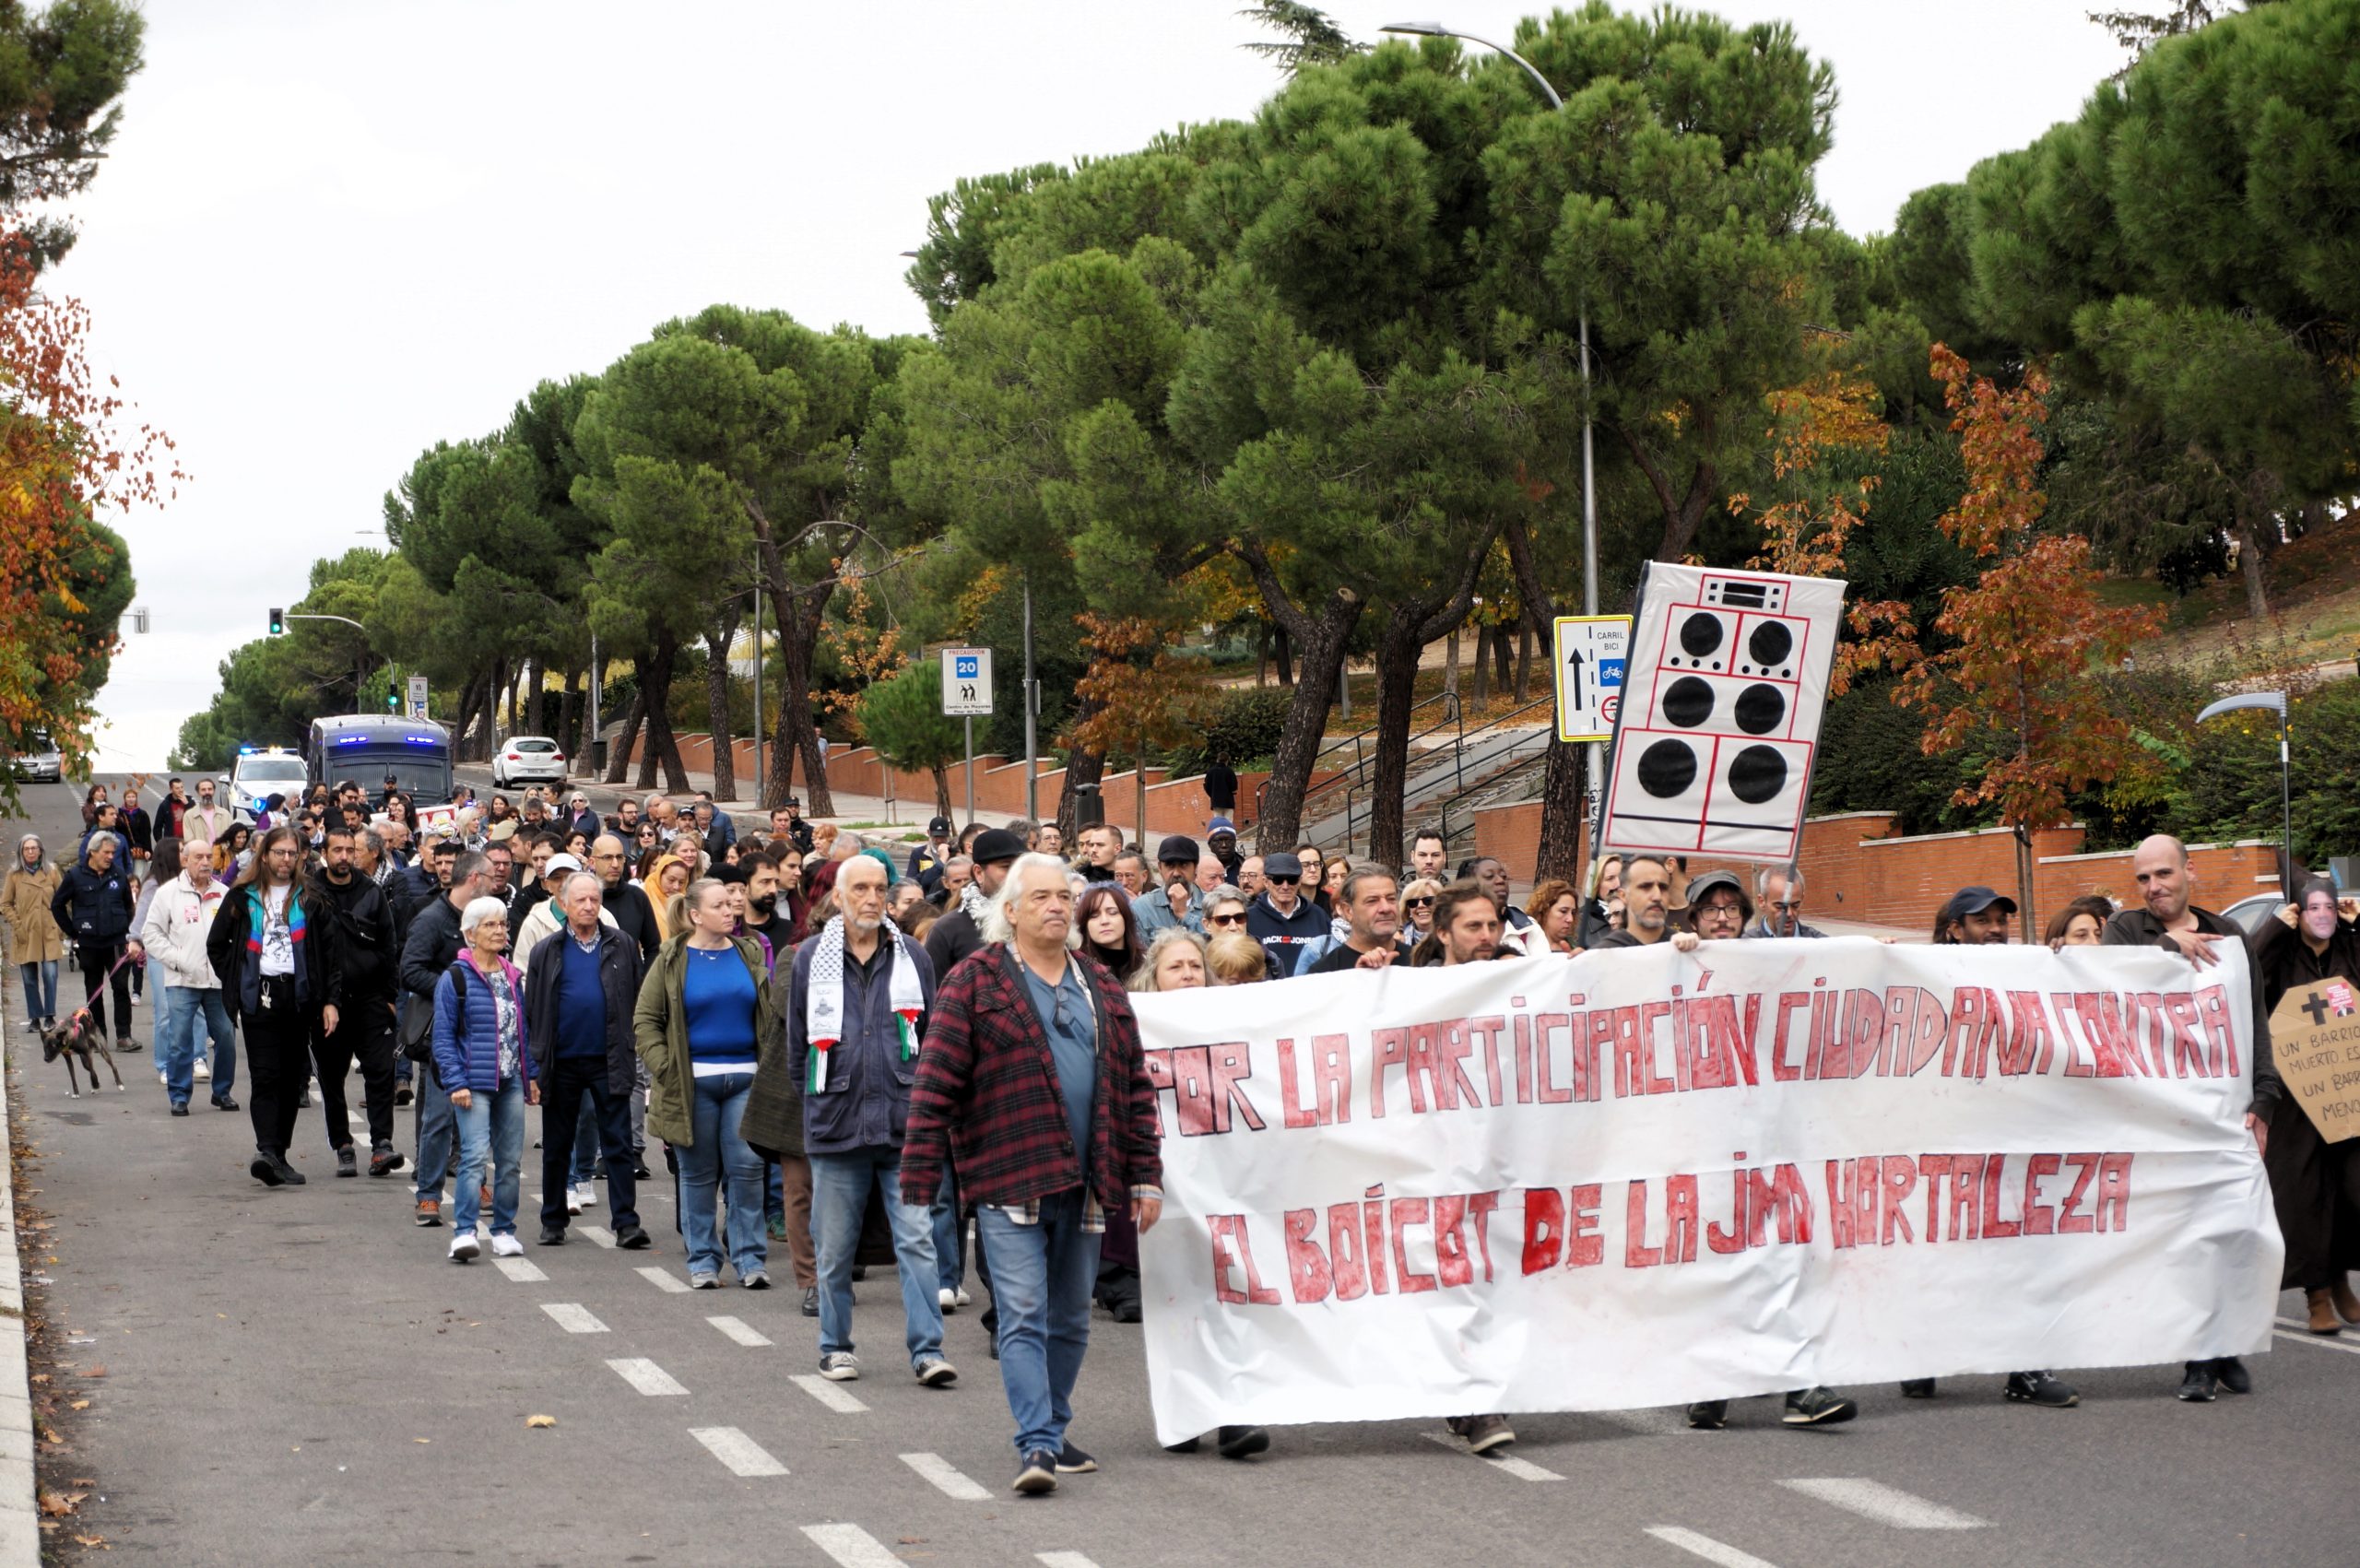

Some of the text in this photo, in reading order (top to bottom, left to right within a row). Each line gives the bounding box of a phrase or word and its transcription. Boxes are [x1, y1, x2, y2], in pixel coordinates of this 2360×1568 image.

[1597, 631, 1624, 640] CARRIL
[1604, 643, 1619, 651] BICI
[959, 662, 976, 673] 20
[1143, 1042, 1267, 1137] POR
[1277, 1032, 1351, 1129] LA
[1372, 971, 1762, 1119] PARTICIPACIÓN
[2050, 984, 2240, 1079] CONTRA
[2279, 1041, 2300, 1057] UN
[2302, 1080, 2325, 1097] UN
[1206, 1214, 1282, 1304] EL
[1522, 1183, 1605, 1277] DE
[1625, 1173, 1699, 1267] LA
[1825, 1151, 2135, 1250] HORTALEZA
